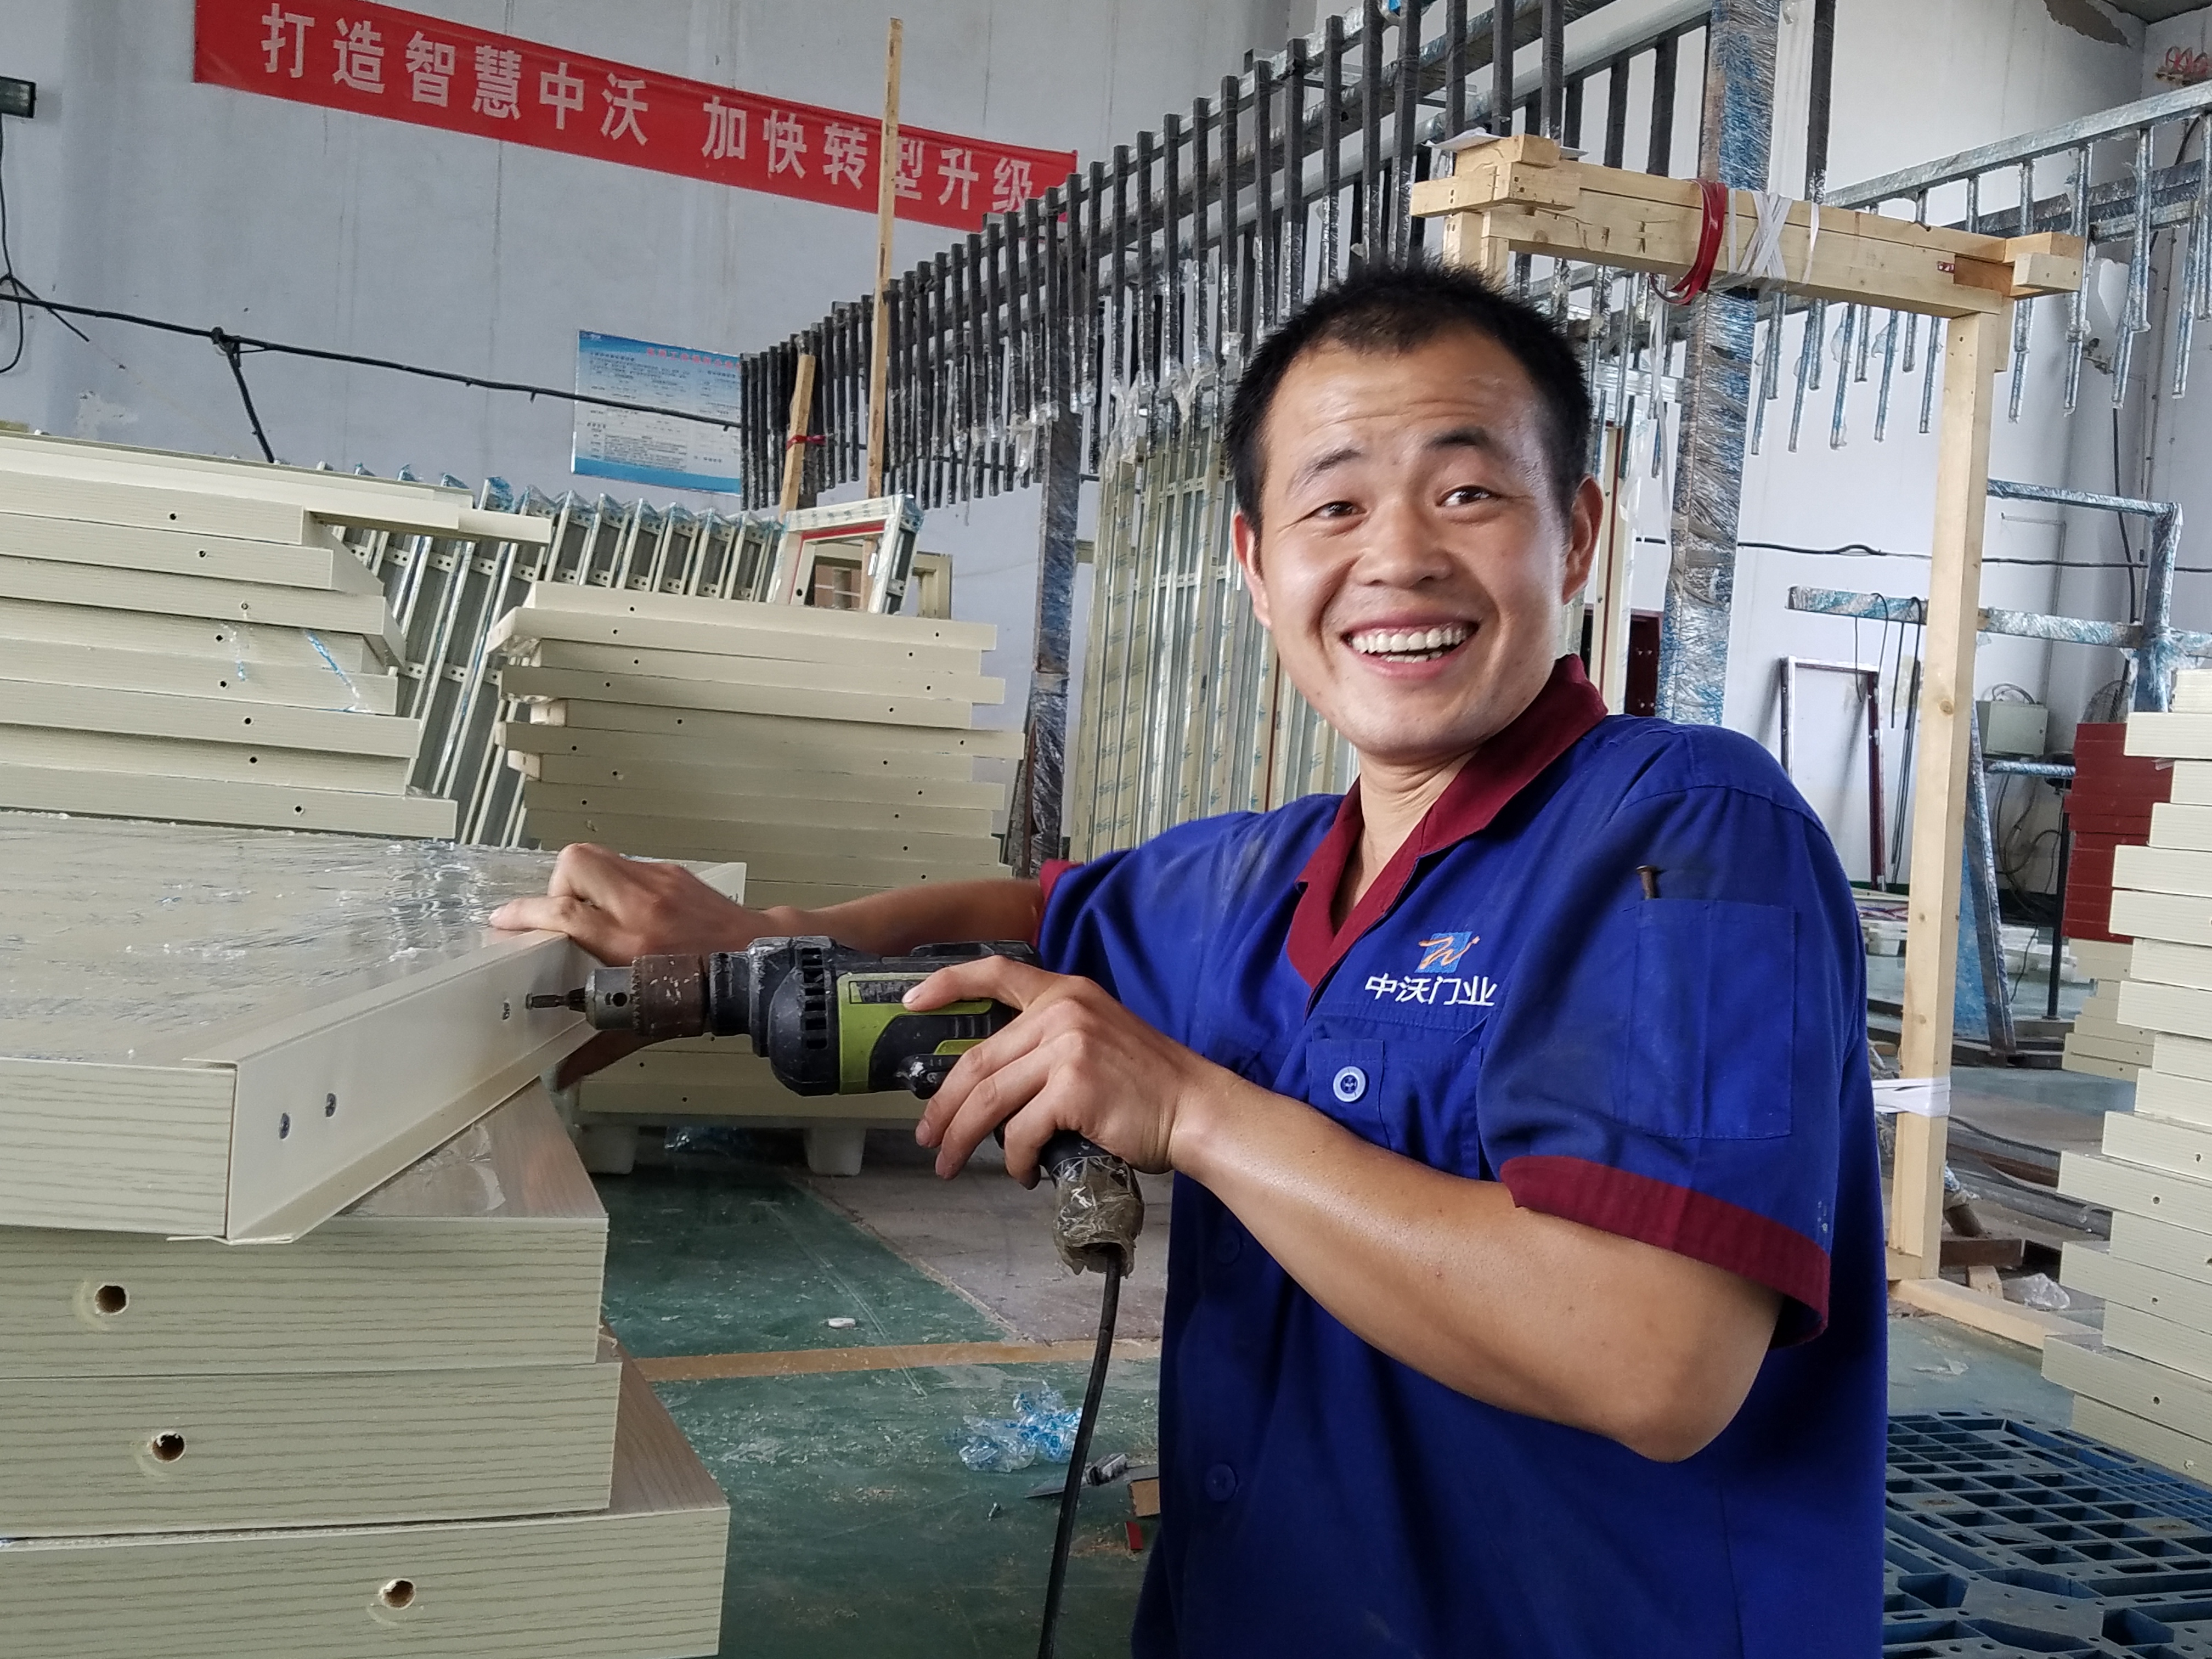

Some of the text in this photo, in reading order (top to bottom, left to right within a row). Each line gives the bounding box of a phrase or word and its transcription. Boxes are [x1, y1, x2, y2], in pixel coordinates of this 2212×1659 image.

[261, 3, 1032, 212] 打造智慧中沃 加快转型升级
[1364, 973, 1498, 1006] 中沃门业
